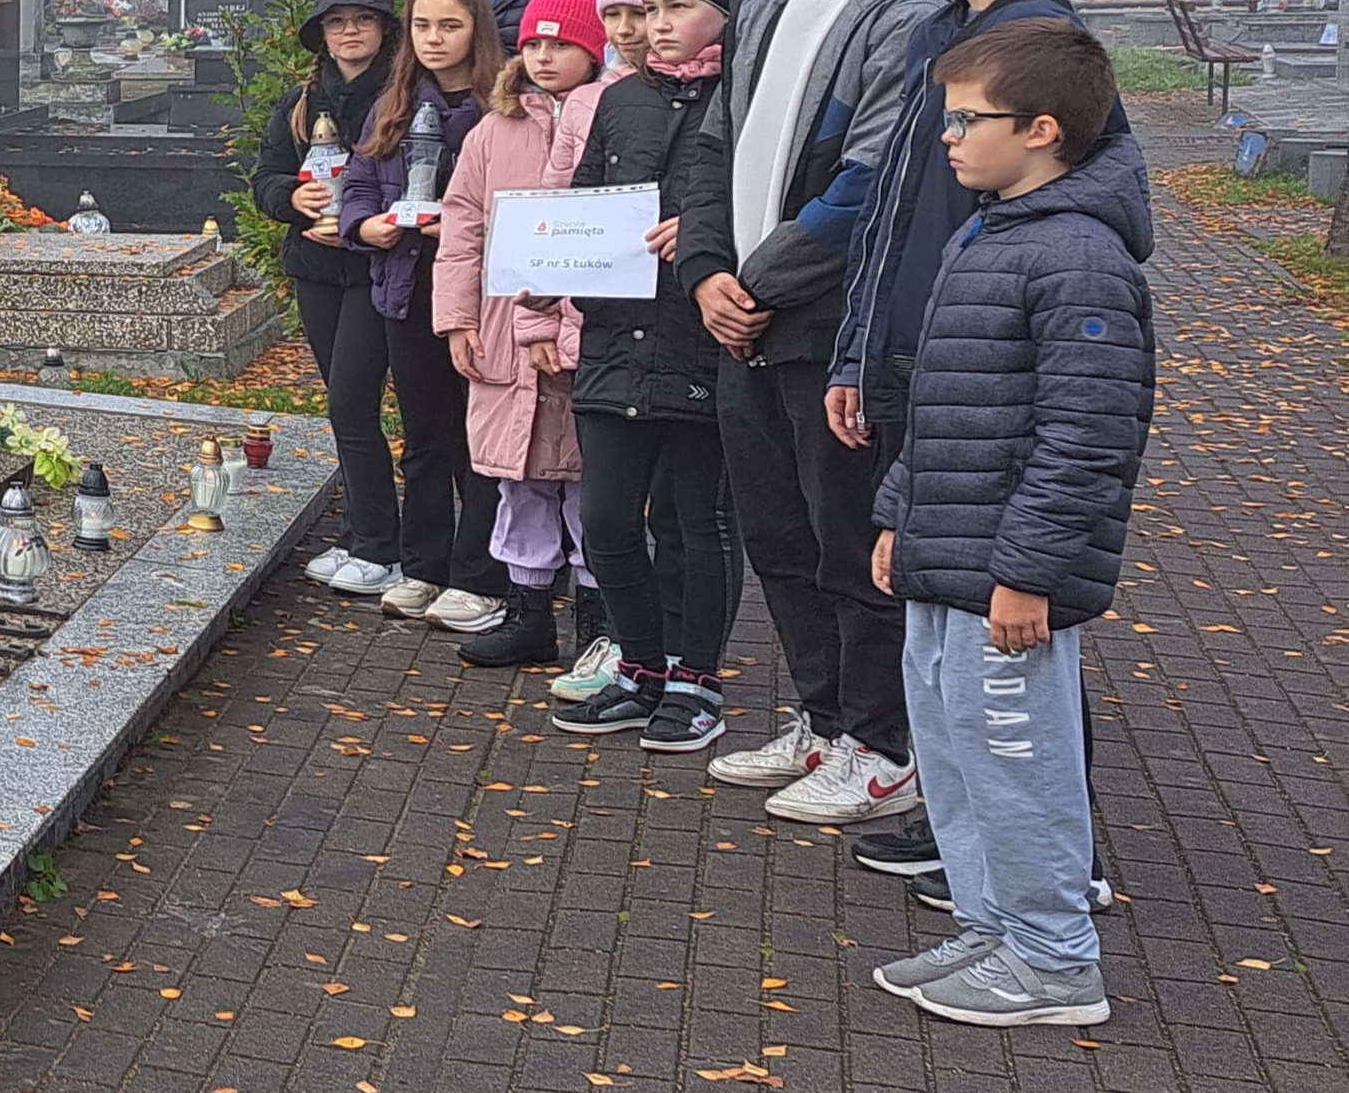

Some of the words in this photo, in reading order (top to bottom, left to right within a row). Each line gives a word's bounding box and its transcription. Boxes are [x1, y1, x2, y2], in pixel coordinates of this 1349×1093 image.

[551, 227, 605, 238] pamięta
[529, 258, 544, 268] SP
[546, 259, 560, 268] nr
[981, 617, 1035, 758] RDAN
